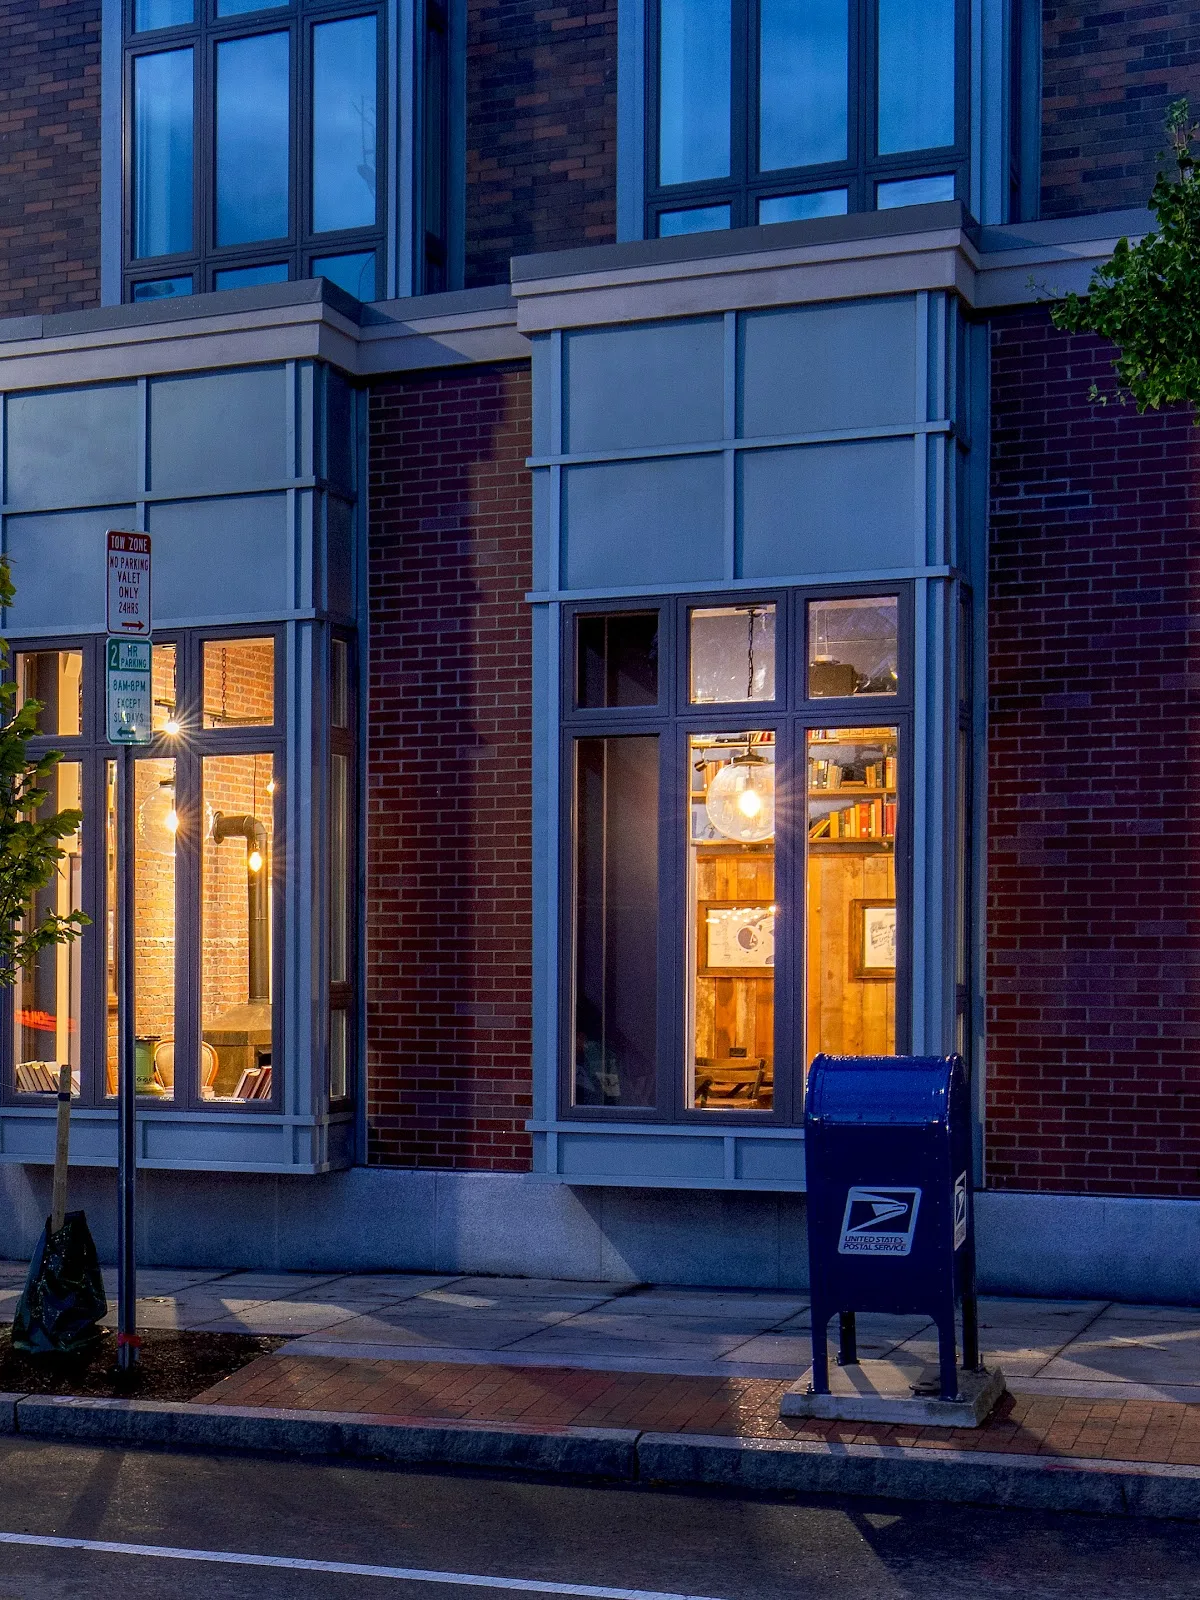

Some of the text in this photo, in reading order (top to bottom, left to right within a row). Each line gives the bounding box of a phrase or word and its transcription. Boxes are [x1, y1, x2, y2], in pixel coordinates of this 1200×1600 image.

[111, 535, 147, 552] TOW ZONE
[110, 556, 148, 571] NO PARKING
[117, 571, 140, 584] VALET
[118, 586, 139, 599] ONLY
[118, 602, 139, 614] 24HRS
[110, 644, 118, 667] 2
[127, 645, 138, 657] HR
[121, 658, 146, 668] PARKING
[113, 680, 146, 692] 8AM-8PM
[117, 698, 140, 708] EXCEPT
